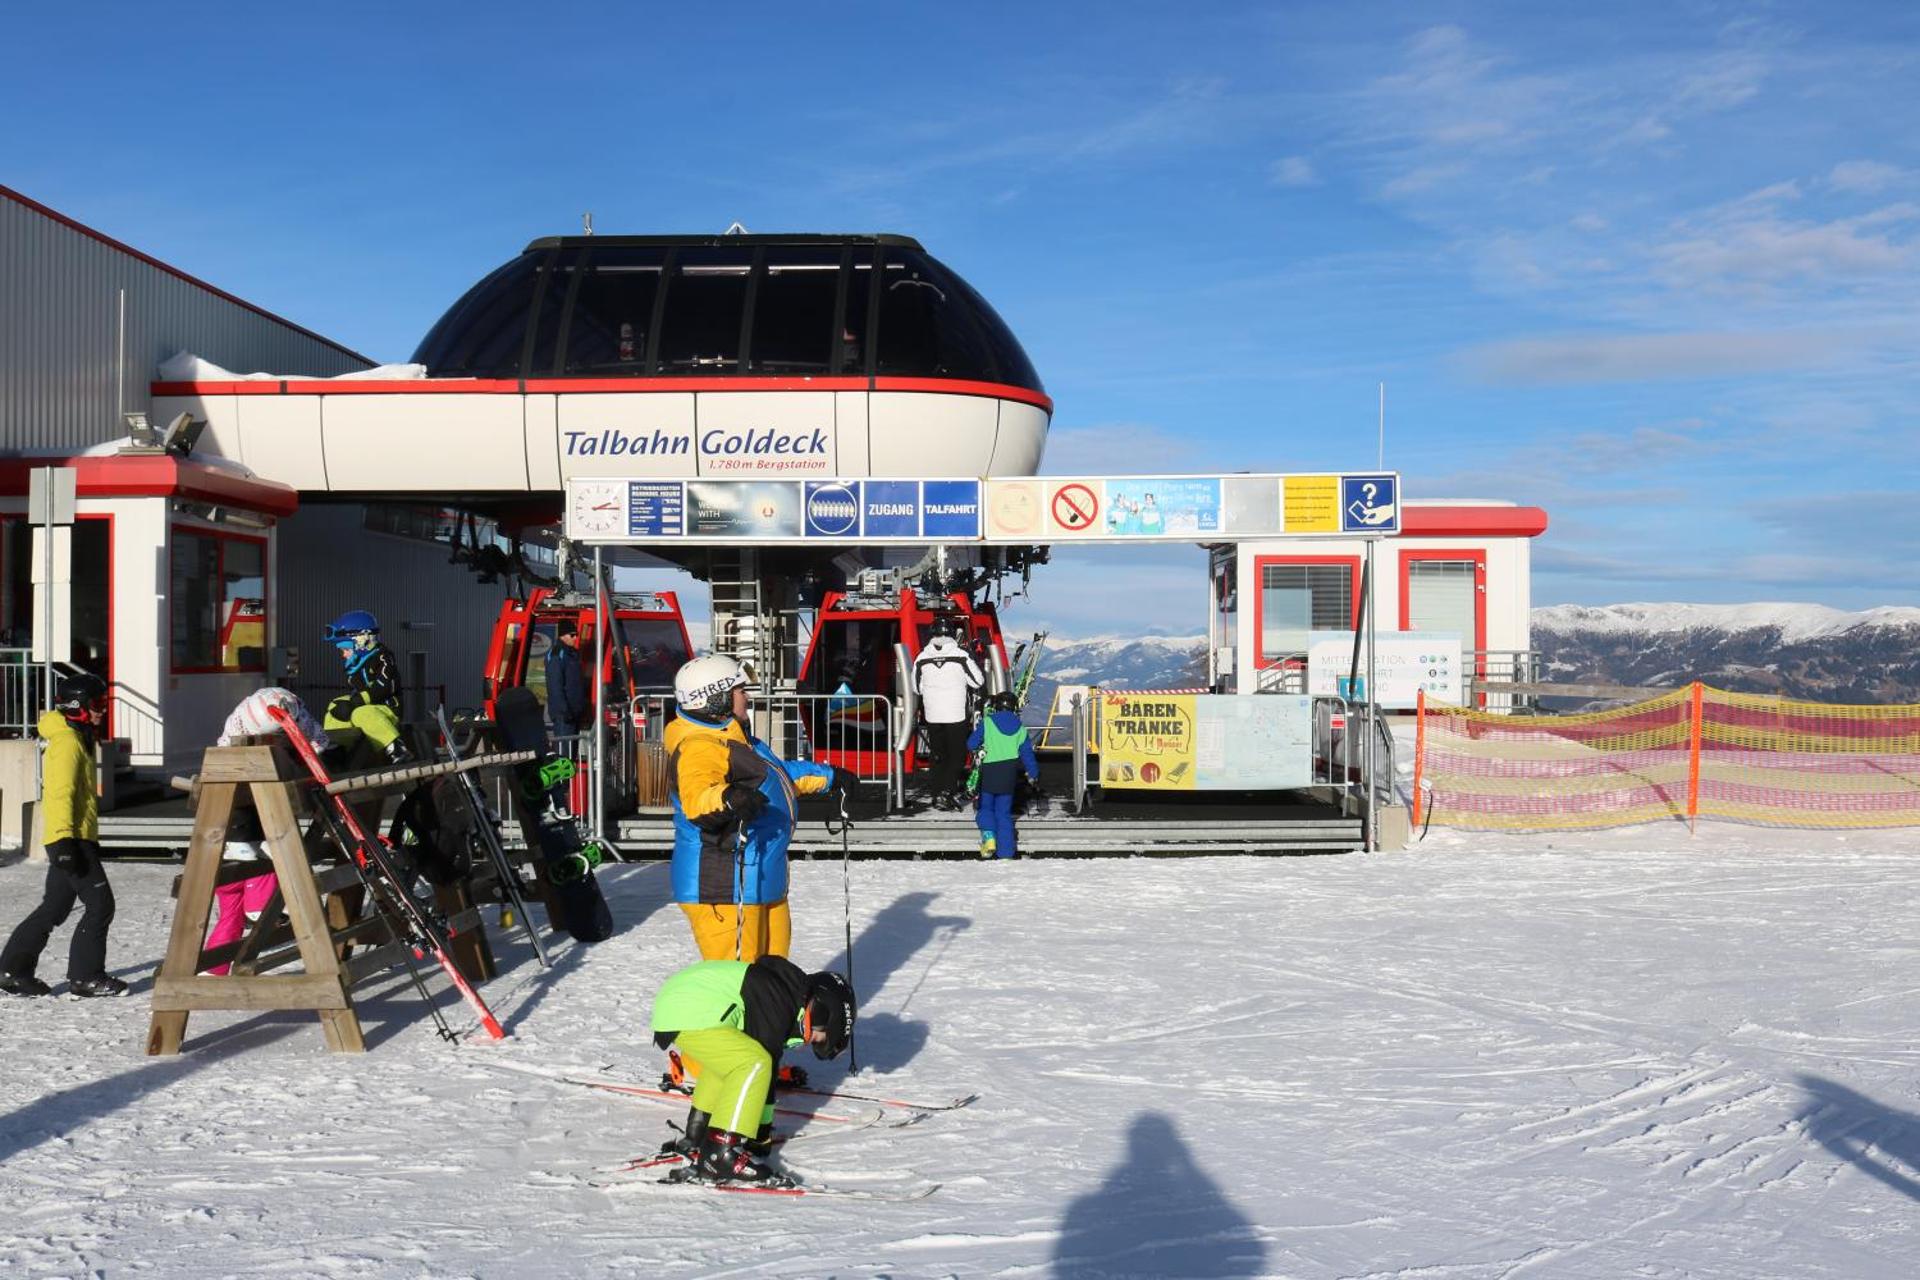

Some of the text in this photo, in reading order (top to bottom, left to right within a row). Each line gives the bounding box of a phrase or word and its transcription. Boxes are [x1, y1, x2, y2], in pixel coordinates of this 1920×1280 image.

[564, 429, 829, 456] Talbahn Goldeck
[757, 460, 827, 471] Bergstation
[698, 510, 720, 518] WITH
[868, 504, 914, 516] ZUGANG
[925, 505, 977, 515] TALFAHRT
[688, 676, 736, 702] SHRED
